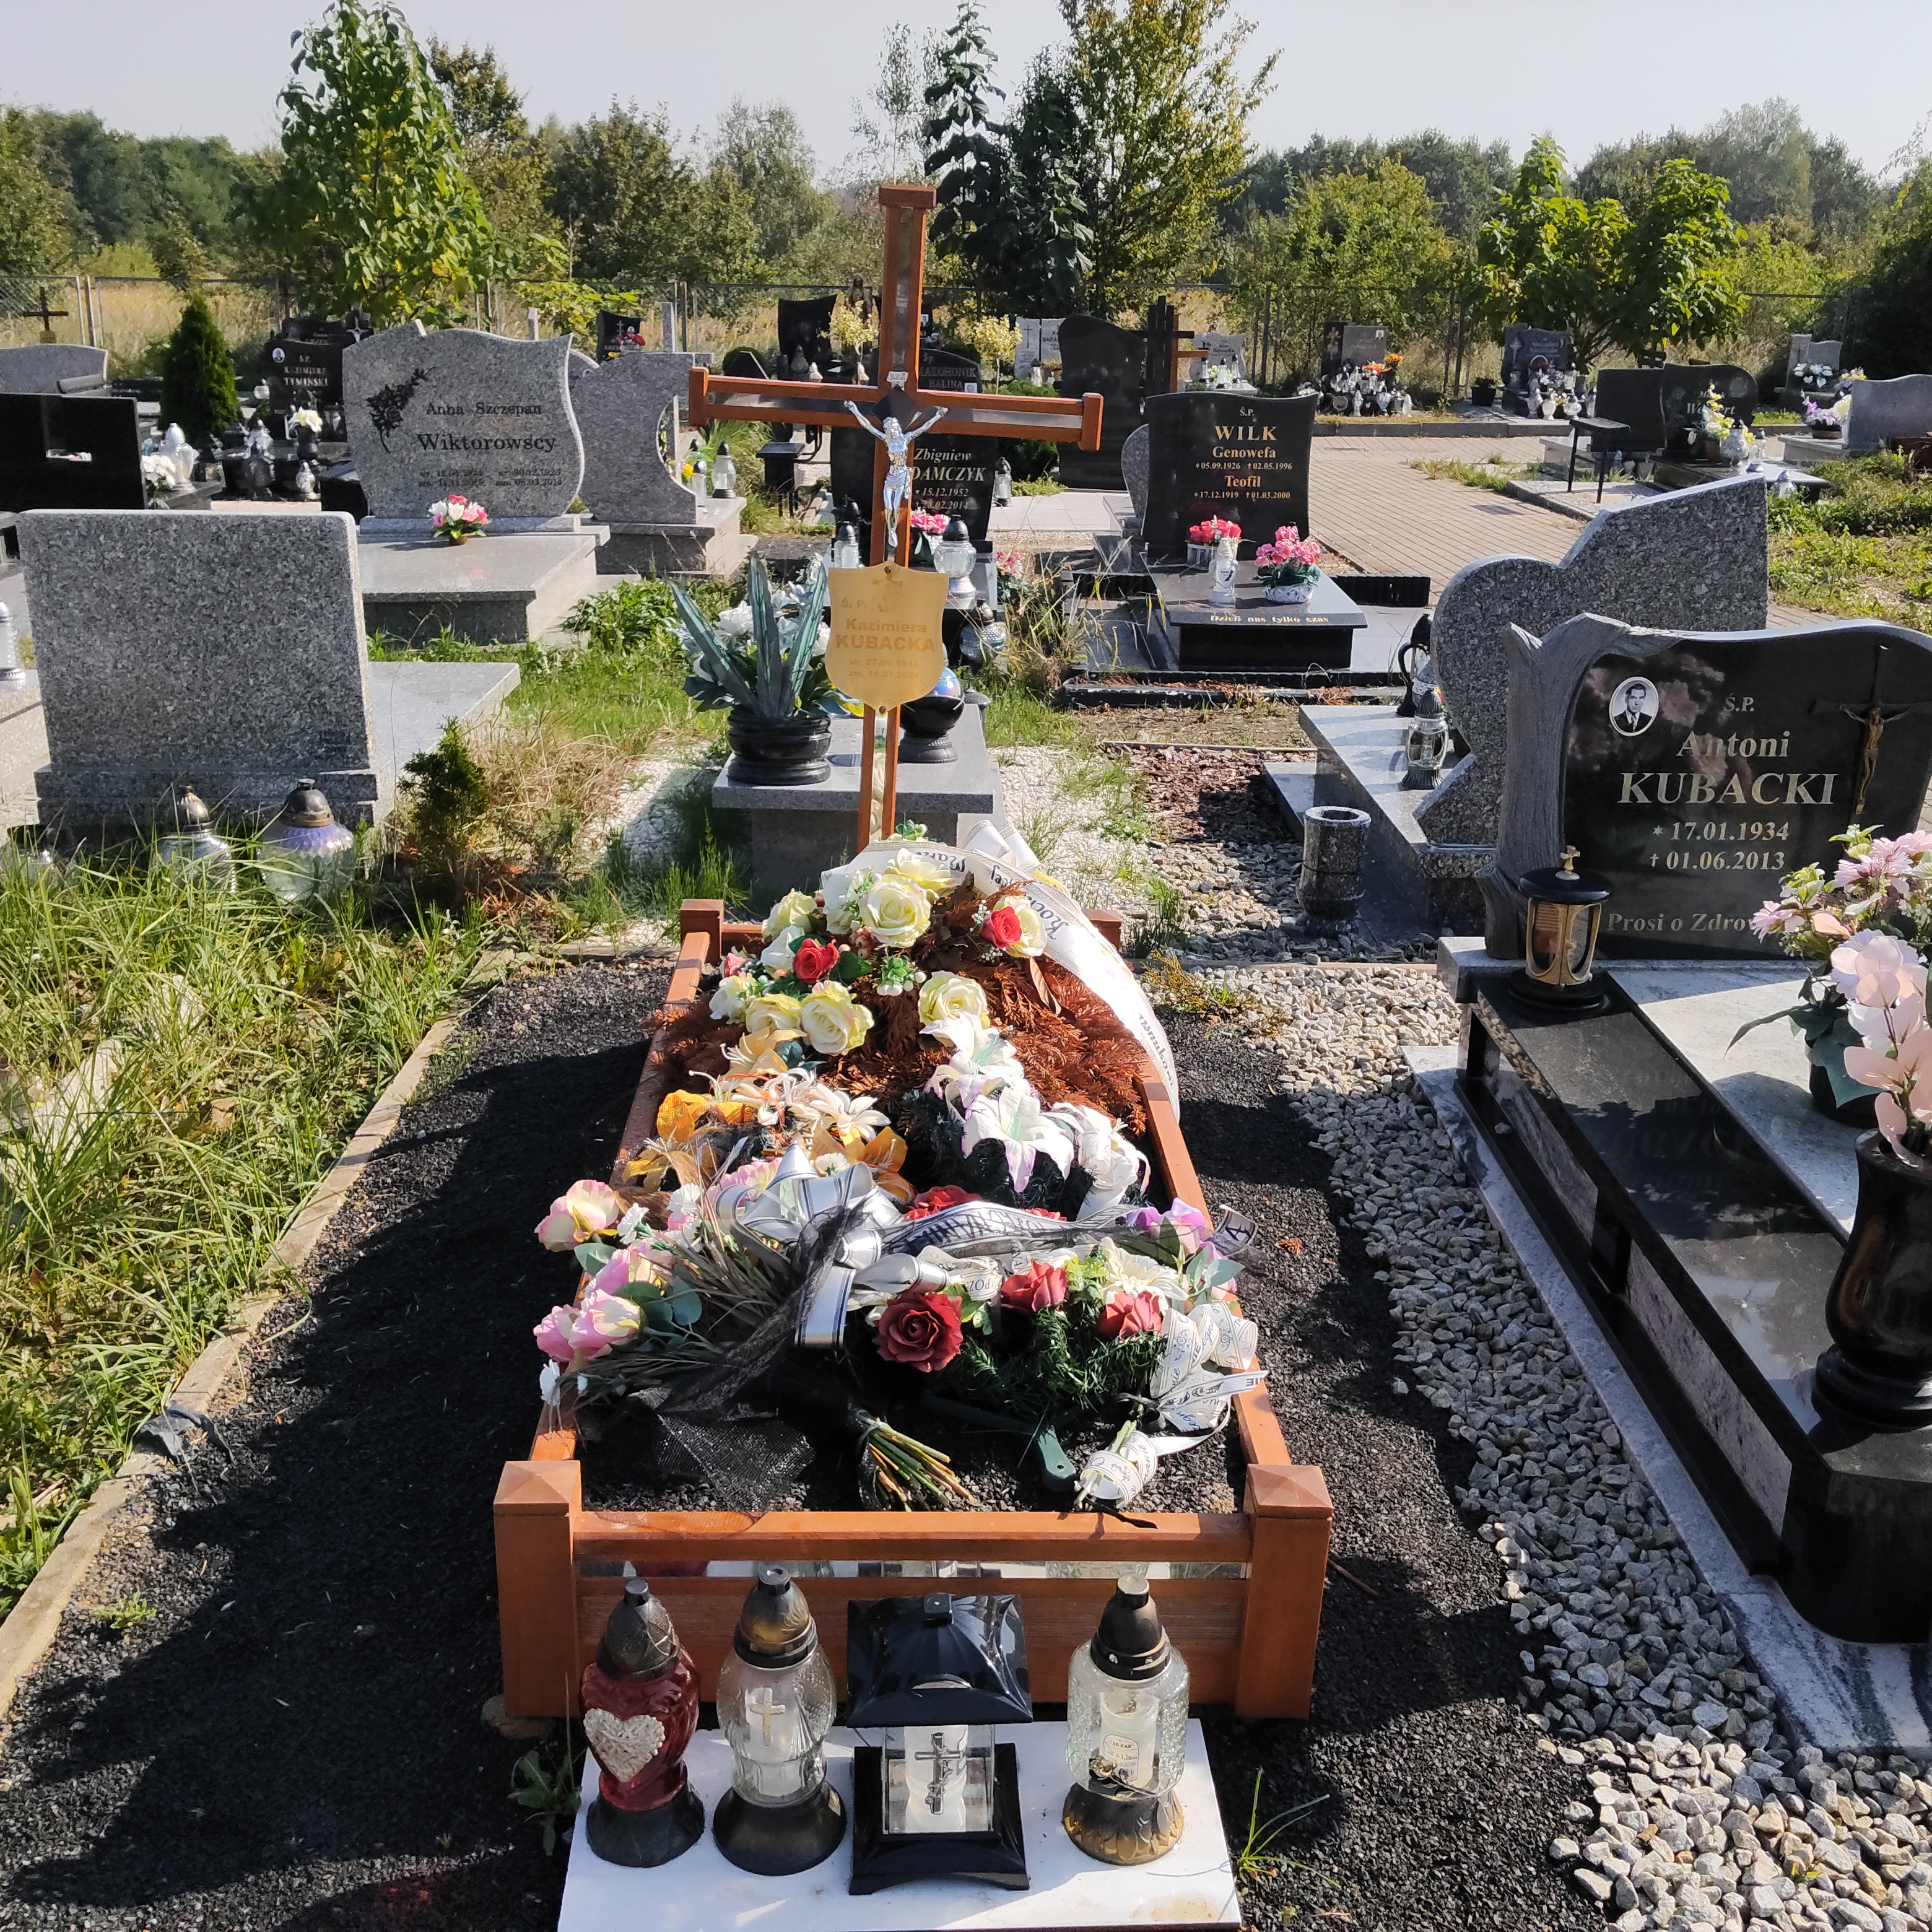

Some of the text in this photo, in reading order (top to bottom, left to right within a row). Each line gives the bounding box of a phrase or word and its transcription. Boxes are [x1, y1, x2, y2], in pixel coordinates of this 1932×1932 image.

[425, 402, 542, 417] Anna Szczepan
[1214, 425, 1277, 441] WILK
[416, 433, 556, 453] Wiktorowscy
[913, 448, 972, 463] Zbigniew
[1212, 446, 1276, 458] Genowefa
[912, 466, 987, 481] DAMCZYK
[1224, 475, 1261, 487] Teofil
[923, 487, 969, 497] 15.12.1952
[845, 619, 927, 633] Kazimiera
[1272, 616, 1300, 624] tylko
[836, 635, 936, 651] KUBACKA
[1724, 693, 1755, 712] Ś.P.
[1676, 730, 1790, 757] Antoni
[1617, 772, 1838, 804] KUBACKI
[1670, 822, 1790, 841] 17.01.1934
[1666, 851, 1785, 870] 01.06.2013
[1608, 913, 1664, 931] Prosi
[1671, 919, 1682, 931] o
